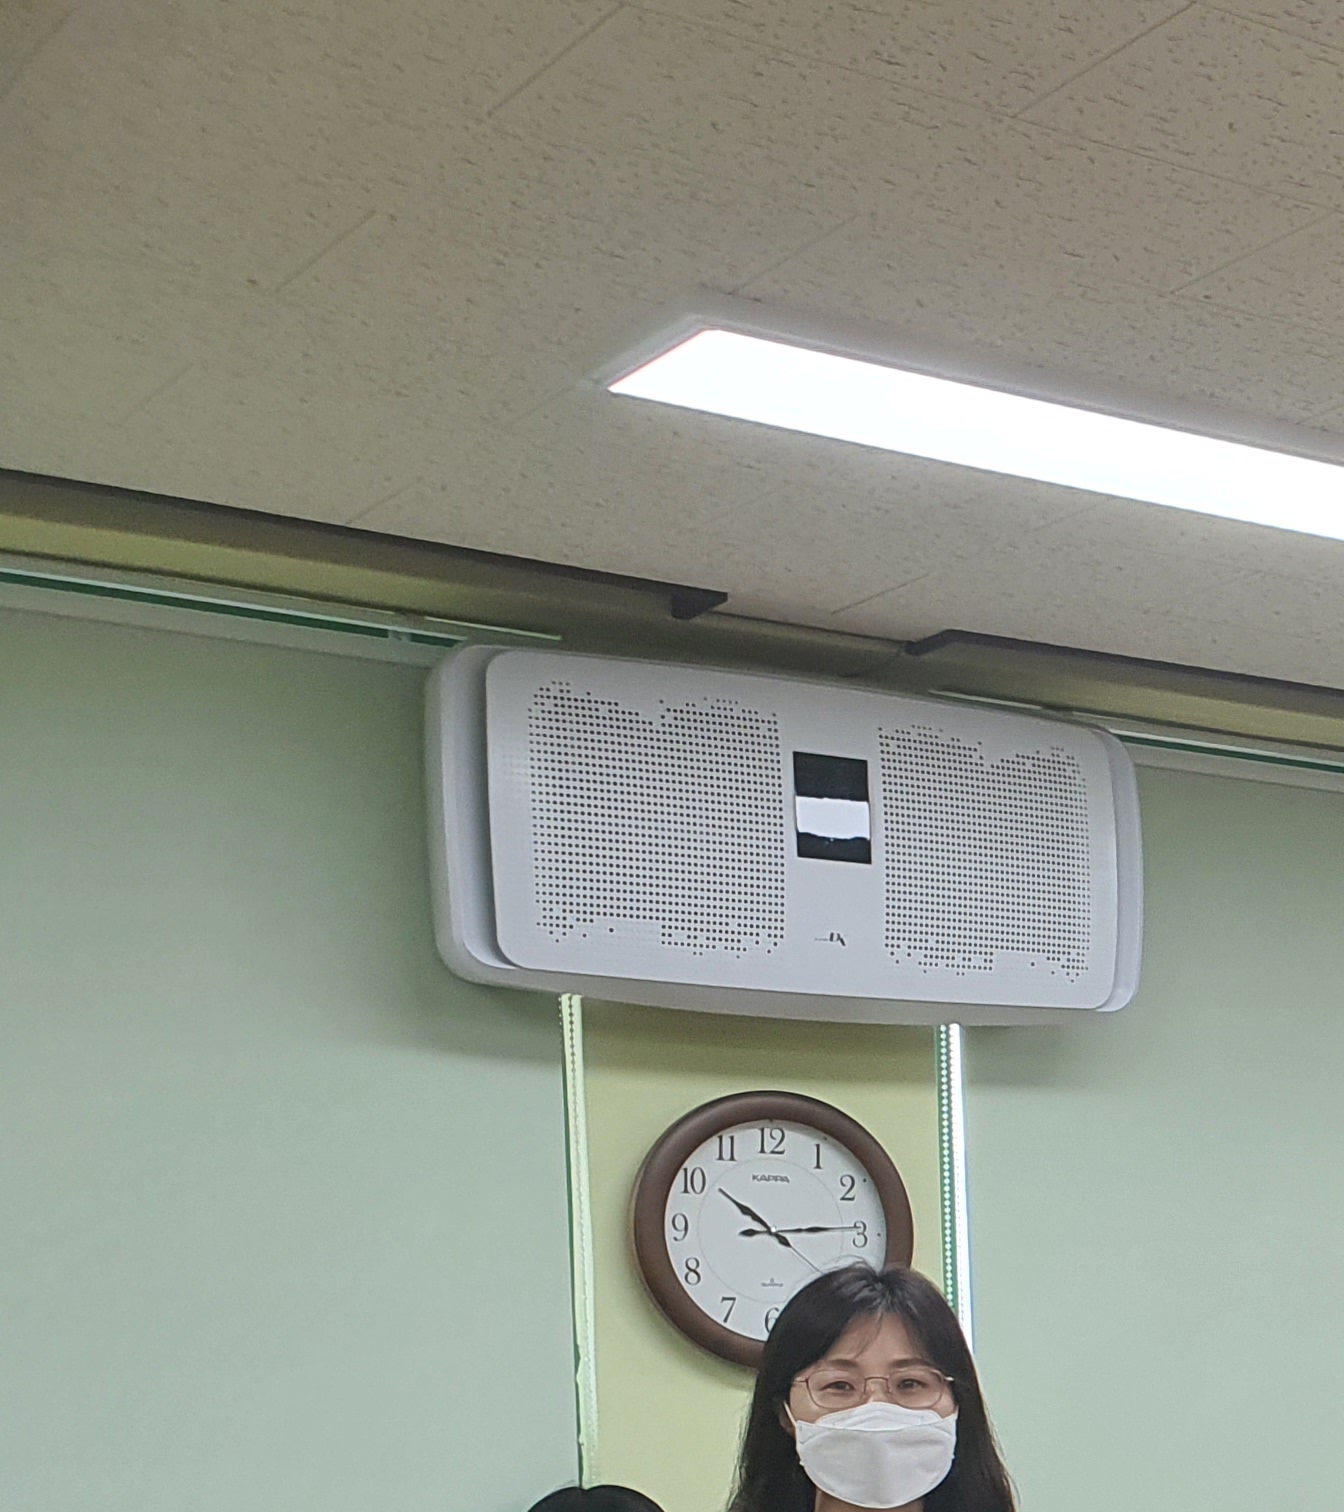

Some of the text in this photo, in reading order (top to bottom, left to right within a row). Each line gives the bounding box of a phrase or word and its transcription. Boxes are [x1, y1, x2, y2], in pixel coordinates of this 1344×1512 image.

[716, 1135, 737, 1162] 11
[758, 1127, 786, 1155] 12
[812, 1143, 824, 1170] 1
[681, 1166, 706, 1195] 10
[839, 1174, 856, 1202] 2
[670, 1212, 689, 1242] 9
[851, 1220, 868, 1248] 3
[683, 1257, 701, 1286] 8
[720, 1297, 736, 1323] 7
